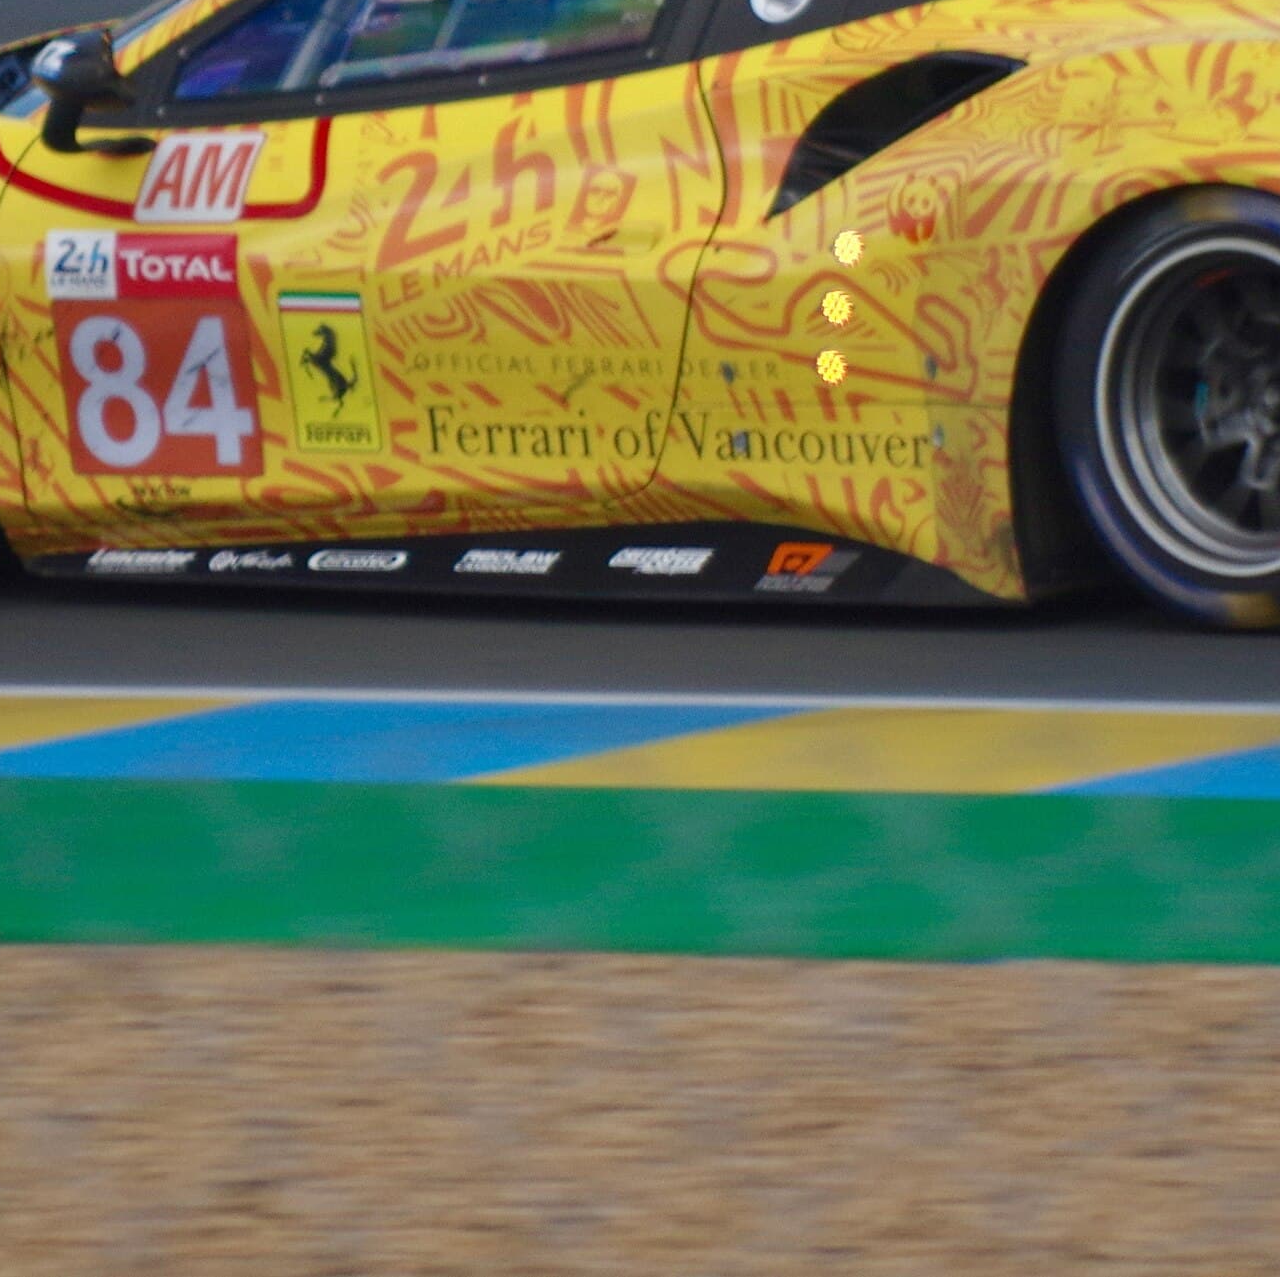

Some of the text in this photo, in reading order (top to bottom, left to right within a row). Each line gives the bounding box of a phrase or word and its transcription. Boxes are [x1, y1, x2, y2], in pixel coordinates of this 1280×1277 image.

[142, 139, 255, 212] AM
[120, 249, 234, 282] TOTAL
[378, 219, 552, 312] LE MANS
[68, 314, 255, 468] 84
[413, 352, 534, 377] OFFICIAL
[552, 354, 664, 379] FERRARI
[426, 404, 934, 469] Ferrari of Vancouver
